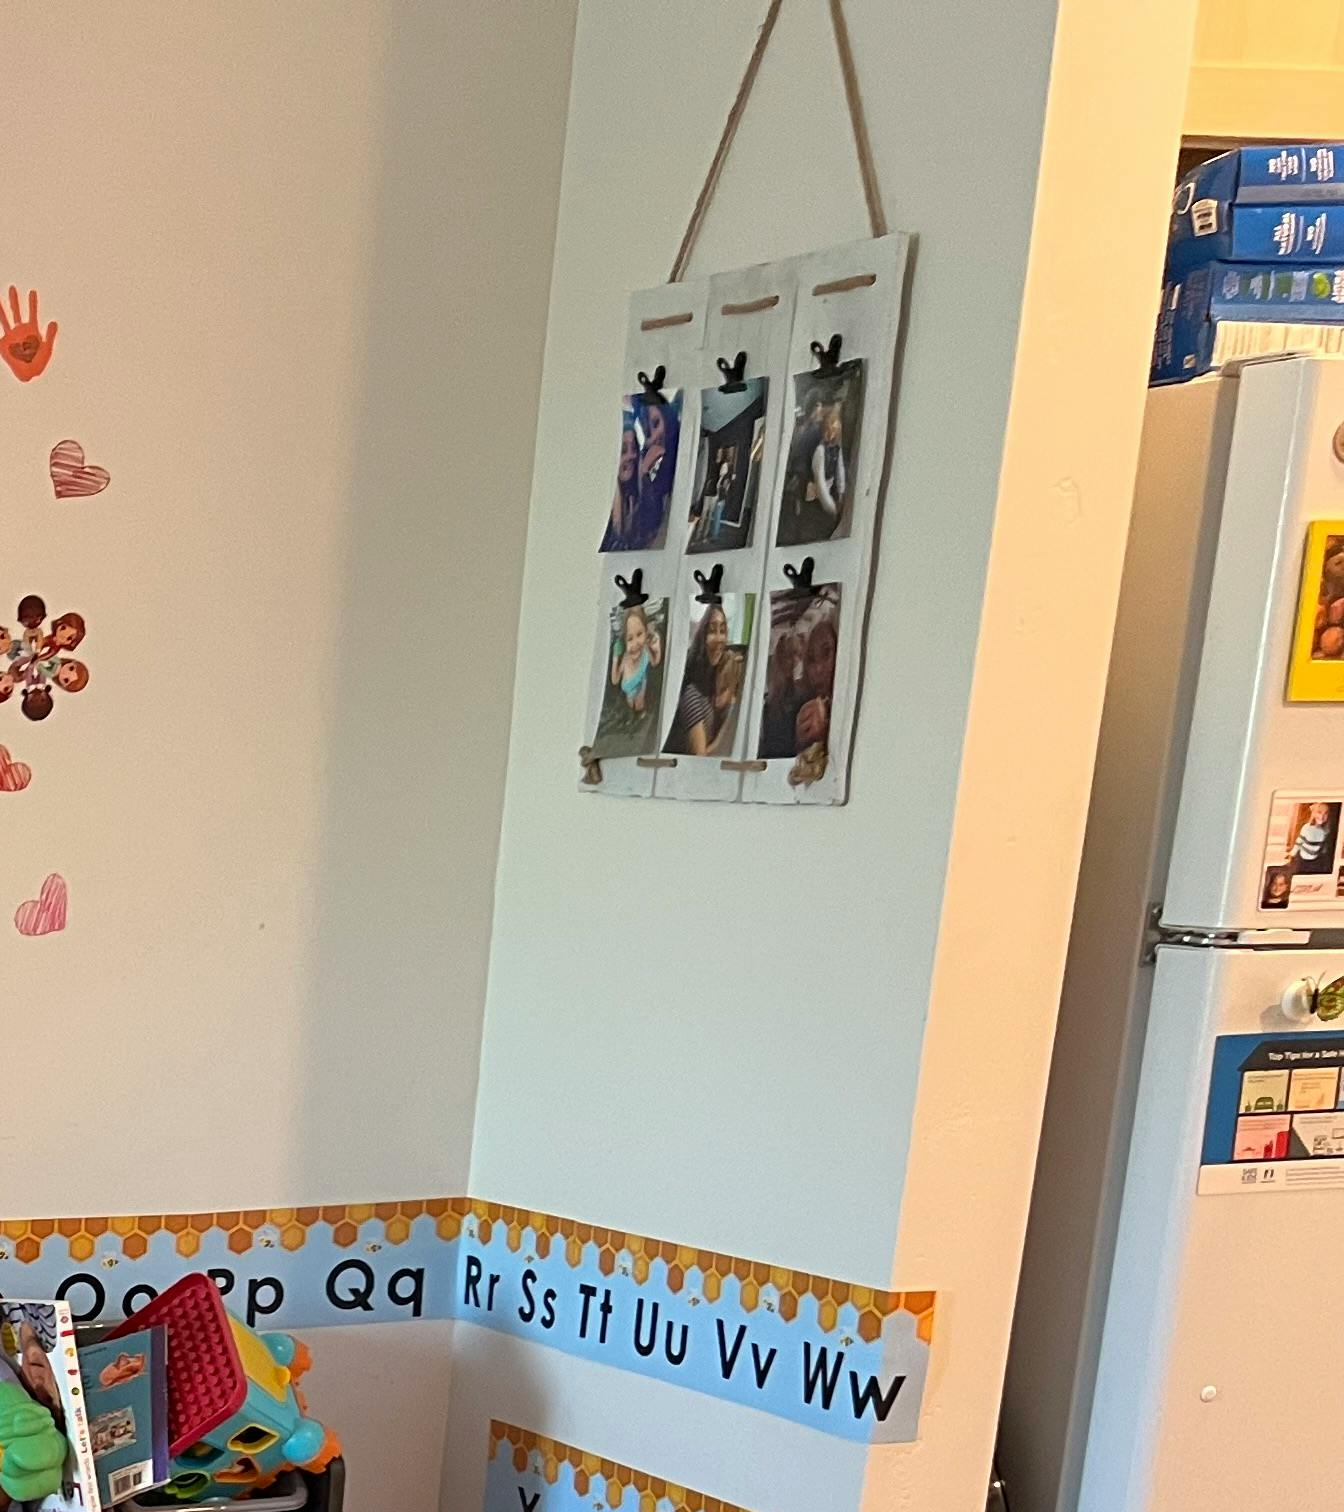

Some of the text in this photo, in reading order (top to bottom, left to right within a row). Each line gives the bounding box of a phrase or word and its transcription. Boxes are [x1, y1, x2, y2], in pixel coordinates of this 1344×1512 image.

[325, 1258, 425, 1318] Qq
[464, 1255, 907, 1422] Rr Ss Tt Uu Vv Ww
